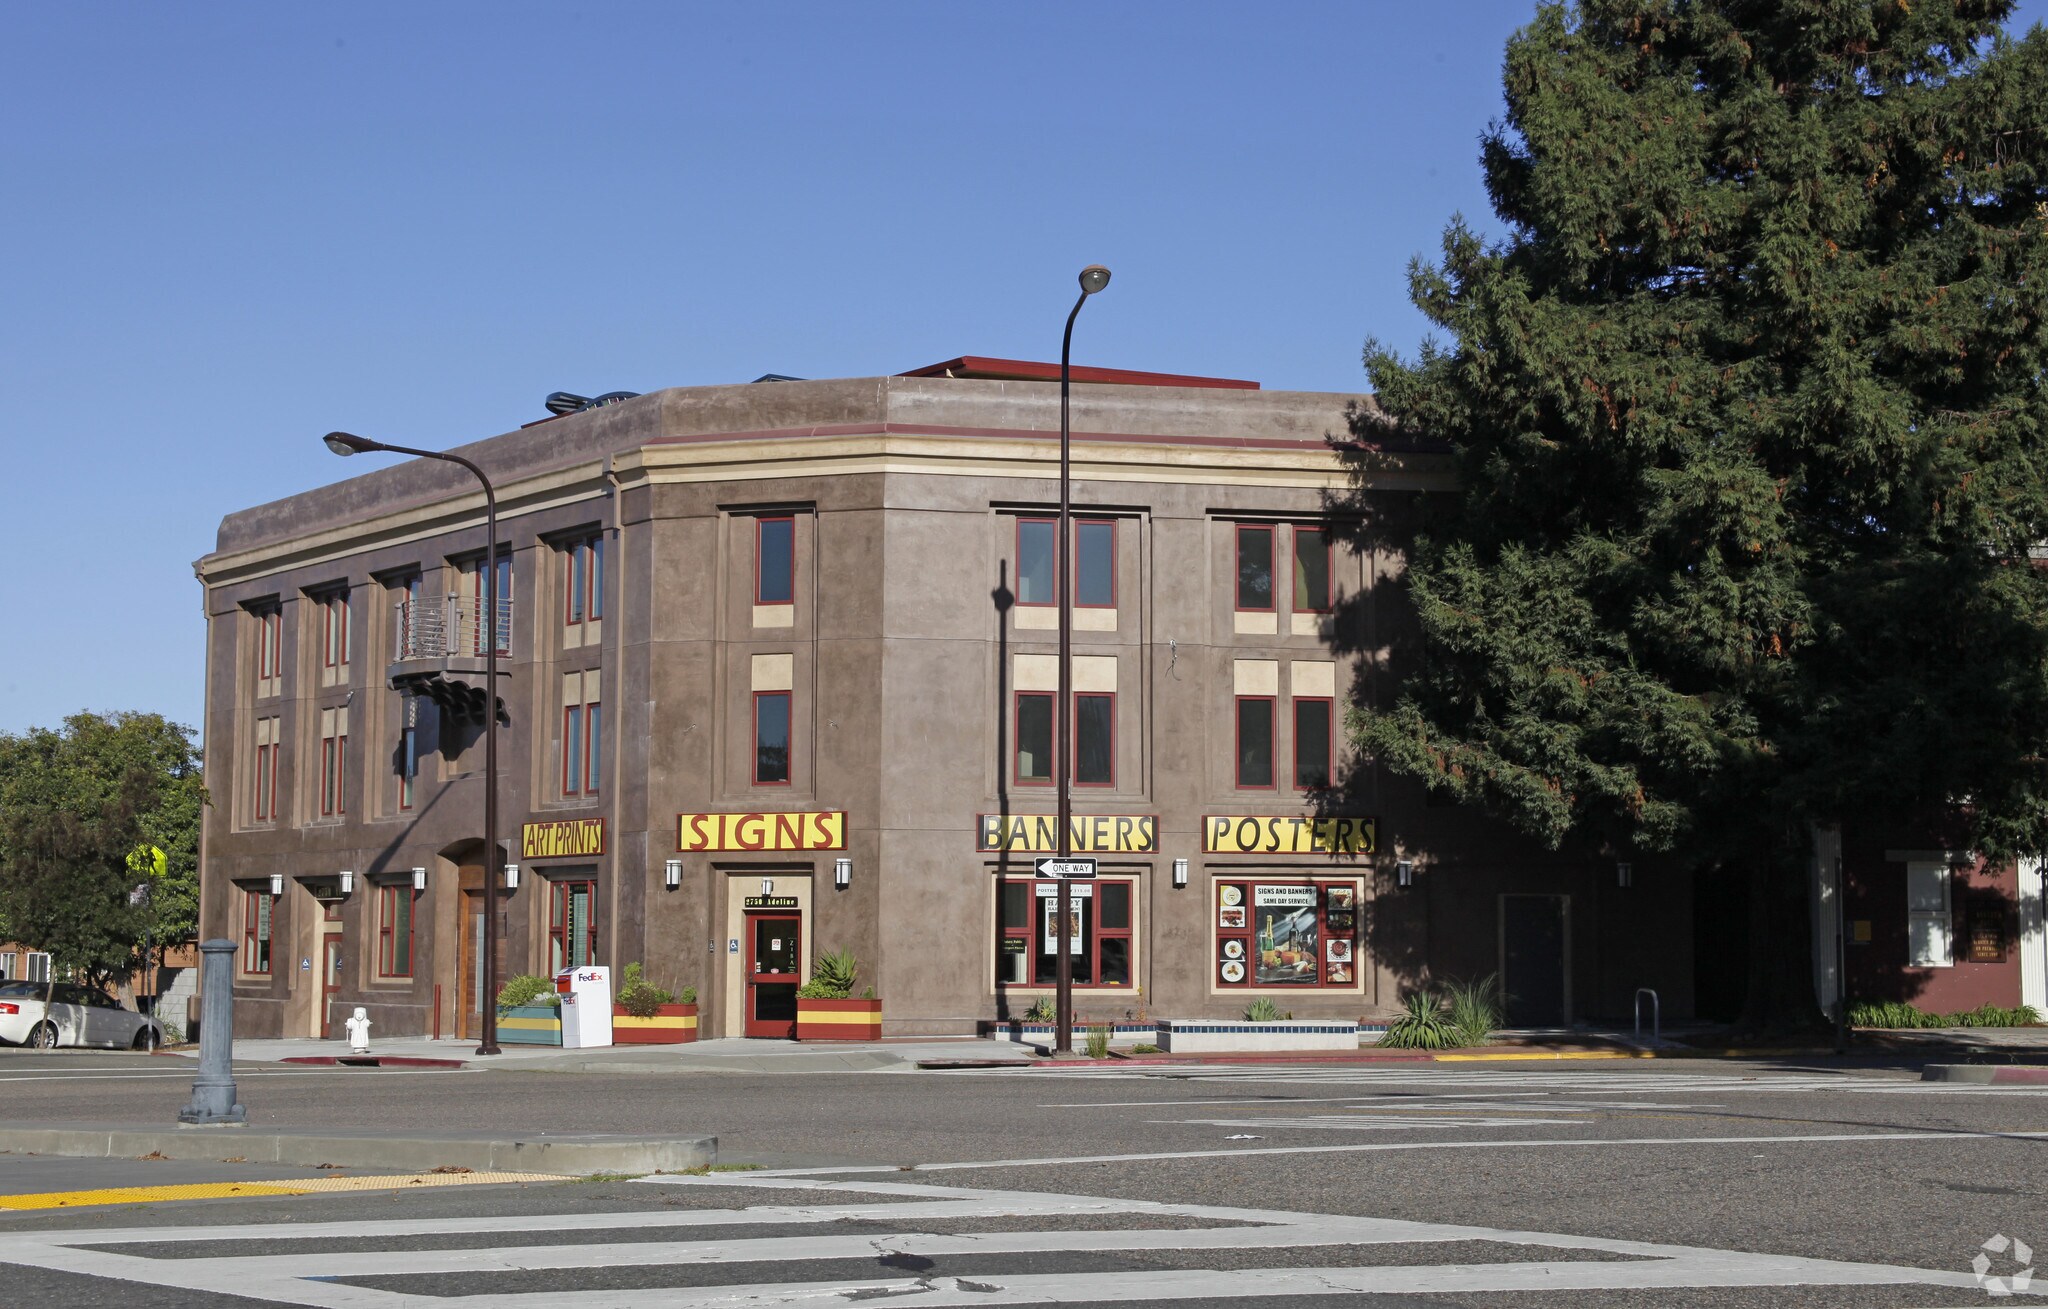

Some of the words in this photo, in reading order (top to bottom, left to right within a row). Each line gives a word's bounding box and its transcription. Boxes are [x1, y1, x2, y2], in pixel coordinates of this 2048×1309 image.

[525, 823, 554, 857] ART
[554, 819, 601, 856] PRINTS
[689, 812, 834, 850] SIGNS
[985, 815, 1152, 851] BANNERS
[1212, 817, 1373, 852] POSTERS
[1052, 864, 1069, 872] ONE
[1072, 864, 1090, 872] WAY
[767, 898, 795, 906] Adeline
[578, 972, 603, 982] FedEx
